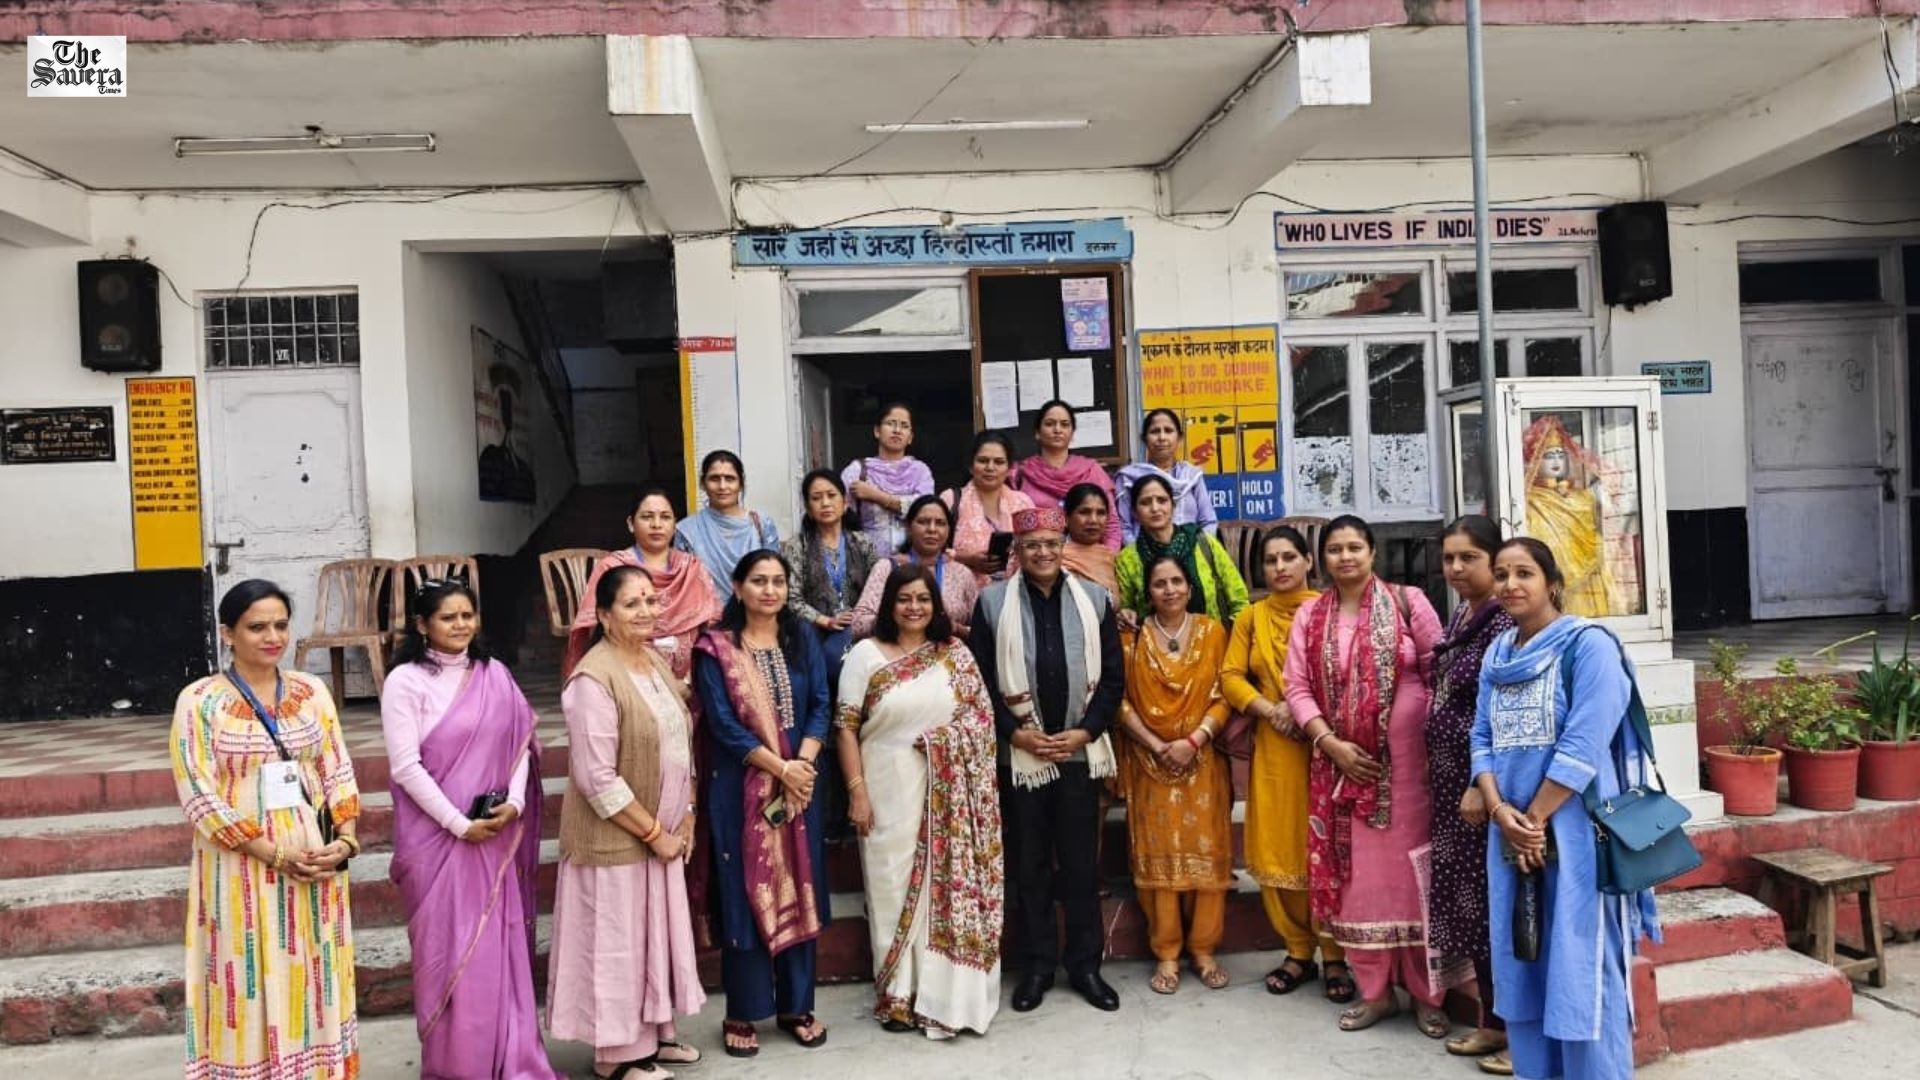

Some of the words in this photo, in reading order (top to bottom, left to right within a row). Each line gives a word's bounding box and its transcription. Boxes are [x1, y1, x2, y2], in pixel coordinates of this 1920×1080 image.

[1331, 221, 1393, 241] LIVES
[1405, 219, 1427, 241] IF
[840, 231, 859, 257] से
[1020, 231, 1075, 253] हमारा
[1143, 365, 1174, 380] WHAT
[1182, 364, 1196, 378] TO
[1223, 360, 1270, 376] DURING
[1146, 383, 1165, 397] AN
[1171, 378, 1266, 396] EARTHQUAKE
[1242, 479, 1273, 496] HOLD
